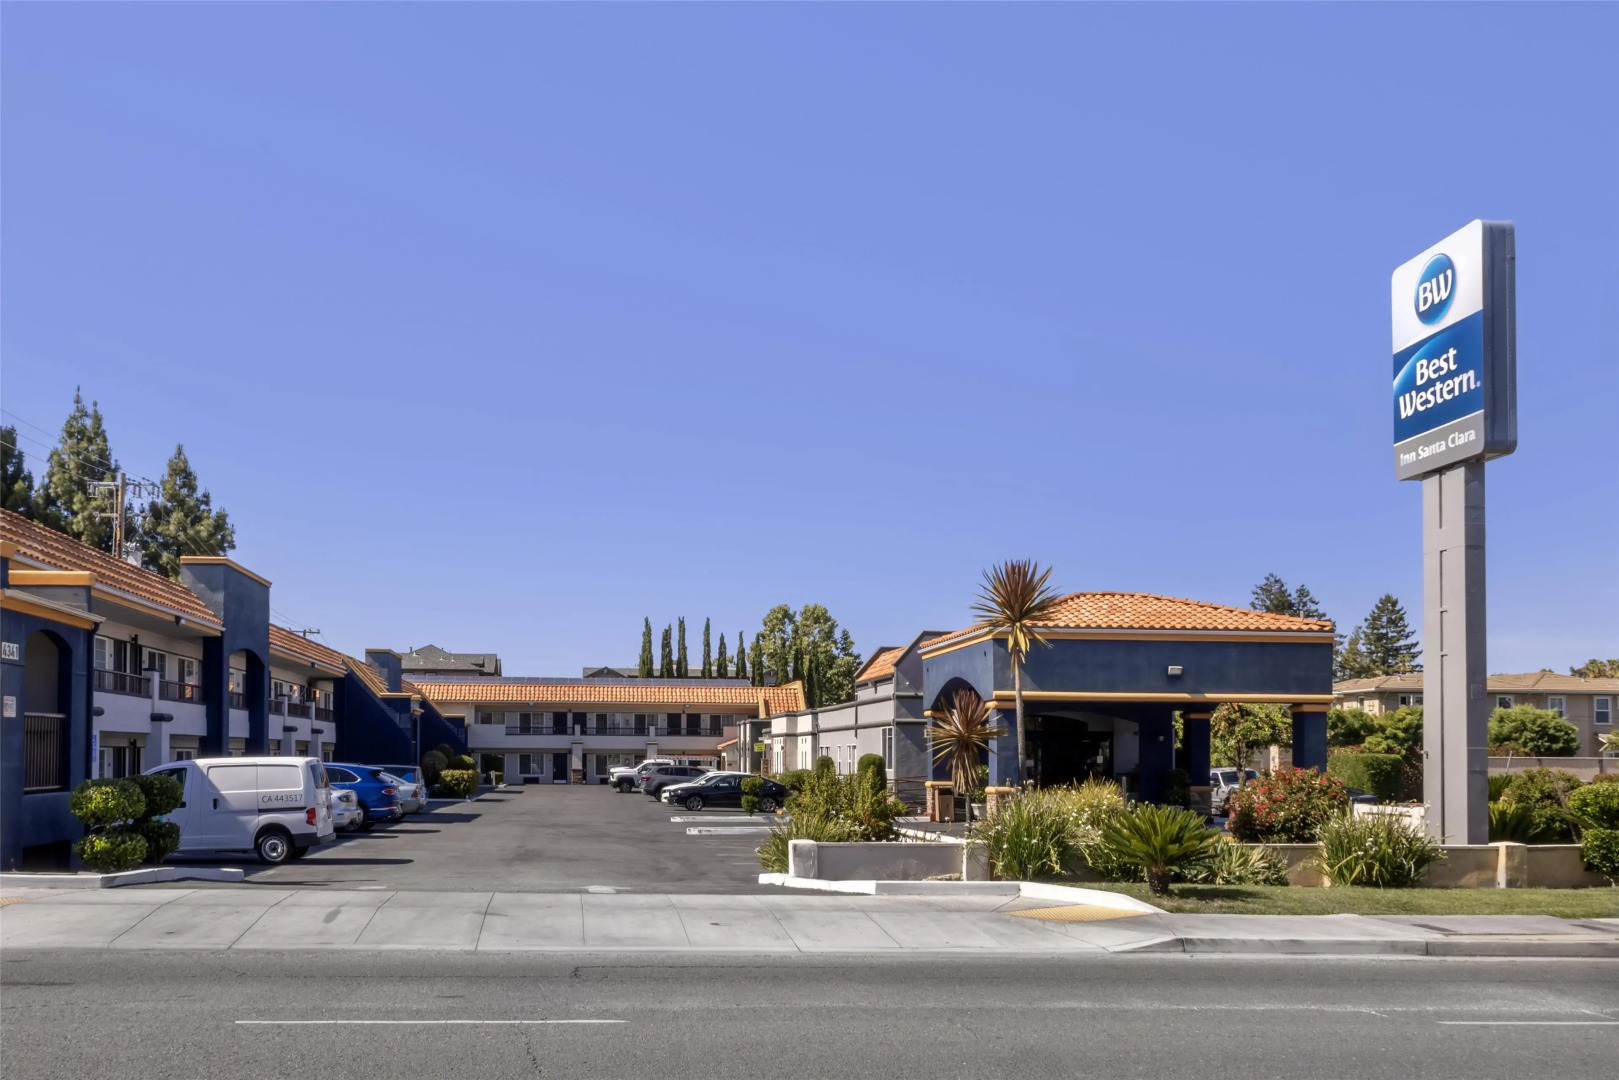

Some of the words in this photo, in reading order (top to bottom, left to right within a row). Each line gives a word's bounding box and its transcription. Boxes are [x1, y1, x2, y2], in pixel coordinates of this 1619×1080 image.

[1418, 268, 1453, 313] BW
[1416, 347, 1457, 386] Best
[1399, 369, 1476, 419] Western
[1400, 451, 1416, 466] Inn
[1418, 440, 1446, 460] Santa
[1448, 429, 1476, 448] Clara
[3, 644, 18, 659] 4341
[261, 795, 273, 804] CA
[274, 793, 303, 803] 443517
